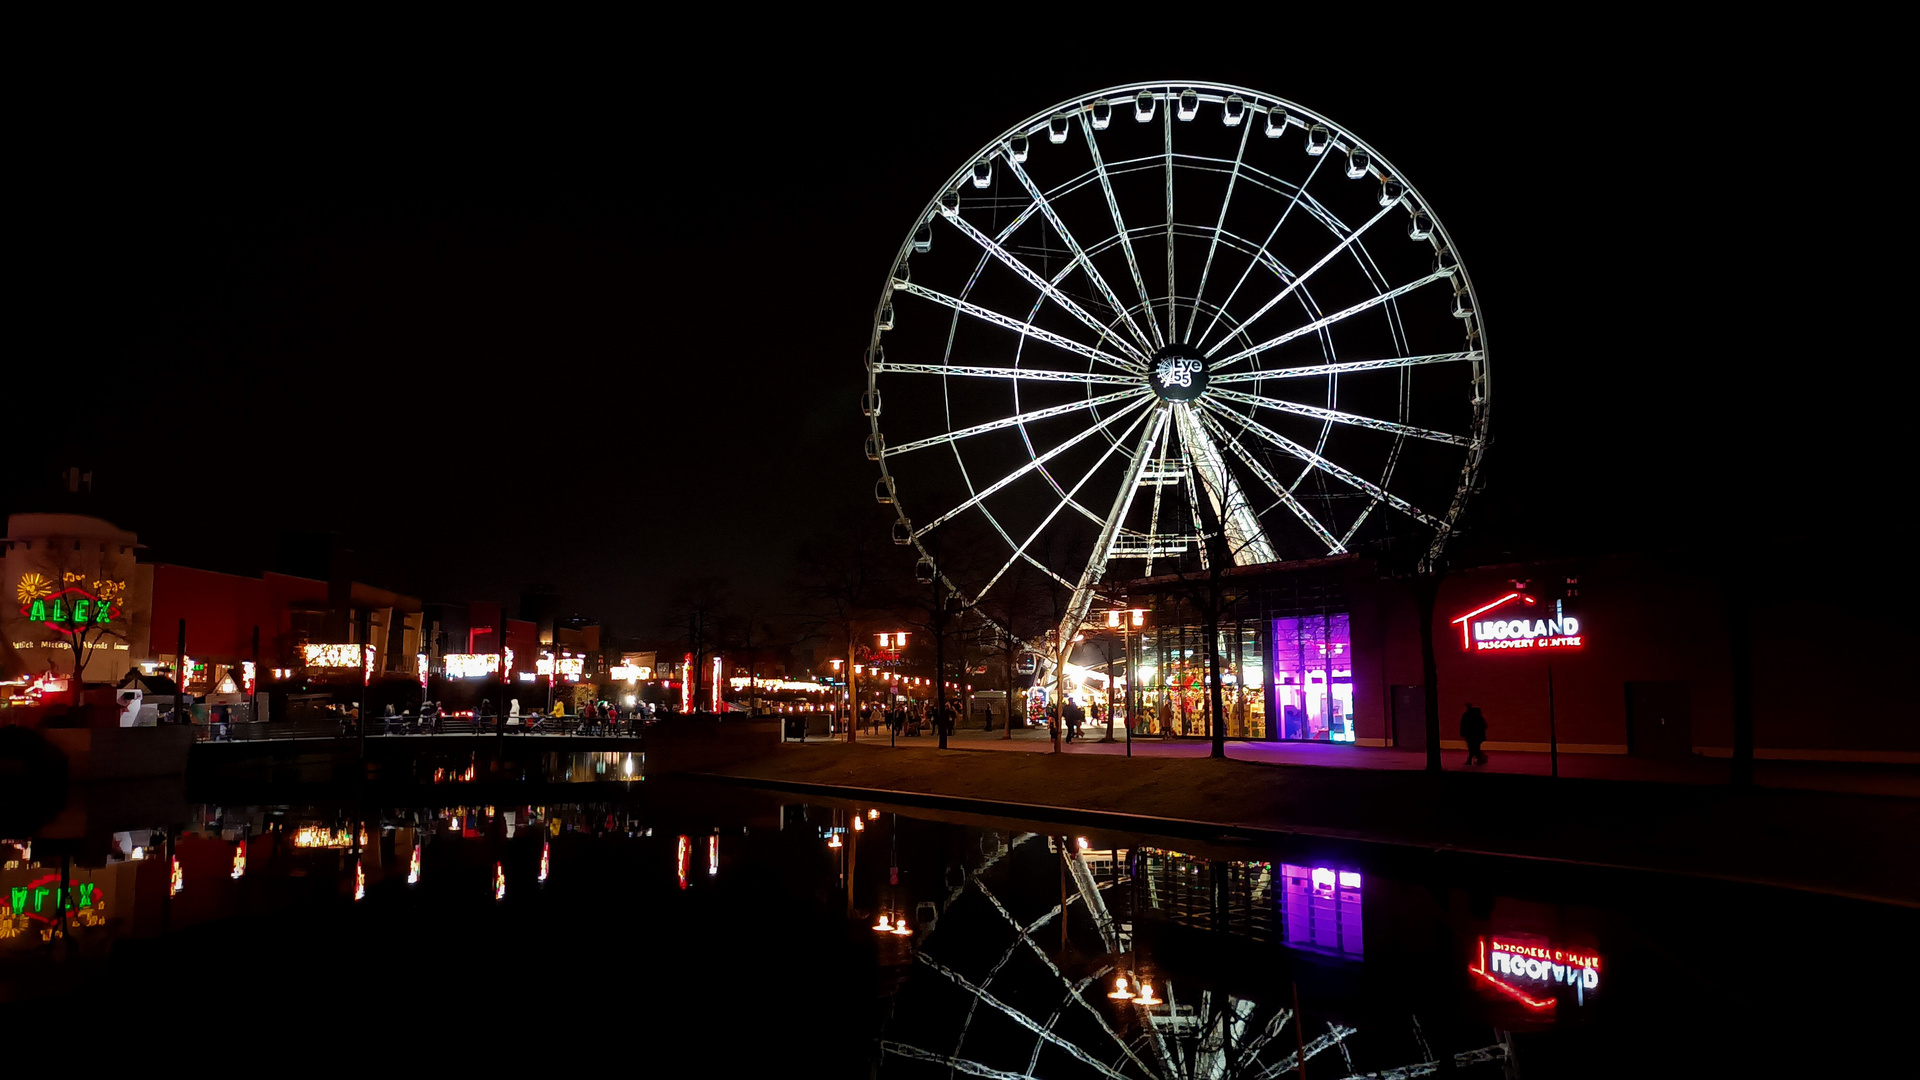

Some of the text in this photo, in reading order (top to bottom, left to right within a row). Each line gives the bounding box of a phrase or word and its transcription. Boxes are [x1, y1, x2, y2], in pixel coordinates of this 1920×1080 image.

[1173, 356, 1202, 372] Eye
[1173, 371, 1191, 386] 55
[30, 599, 110, 623] ALEX
[1474, 617, 1579, 640] LEGOLAND
[1477, 640, 1534, 650] DISCOVERY
